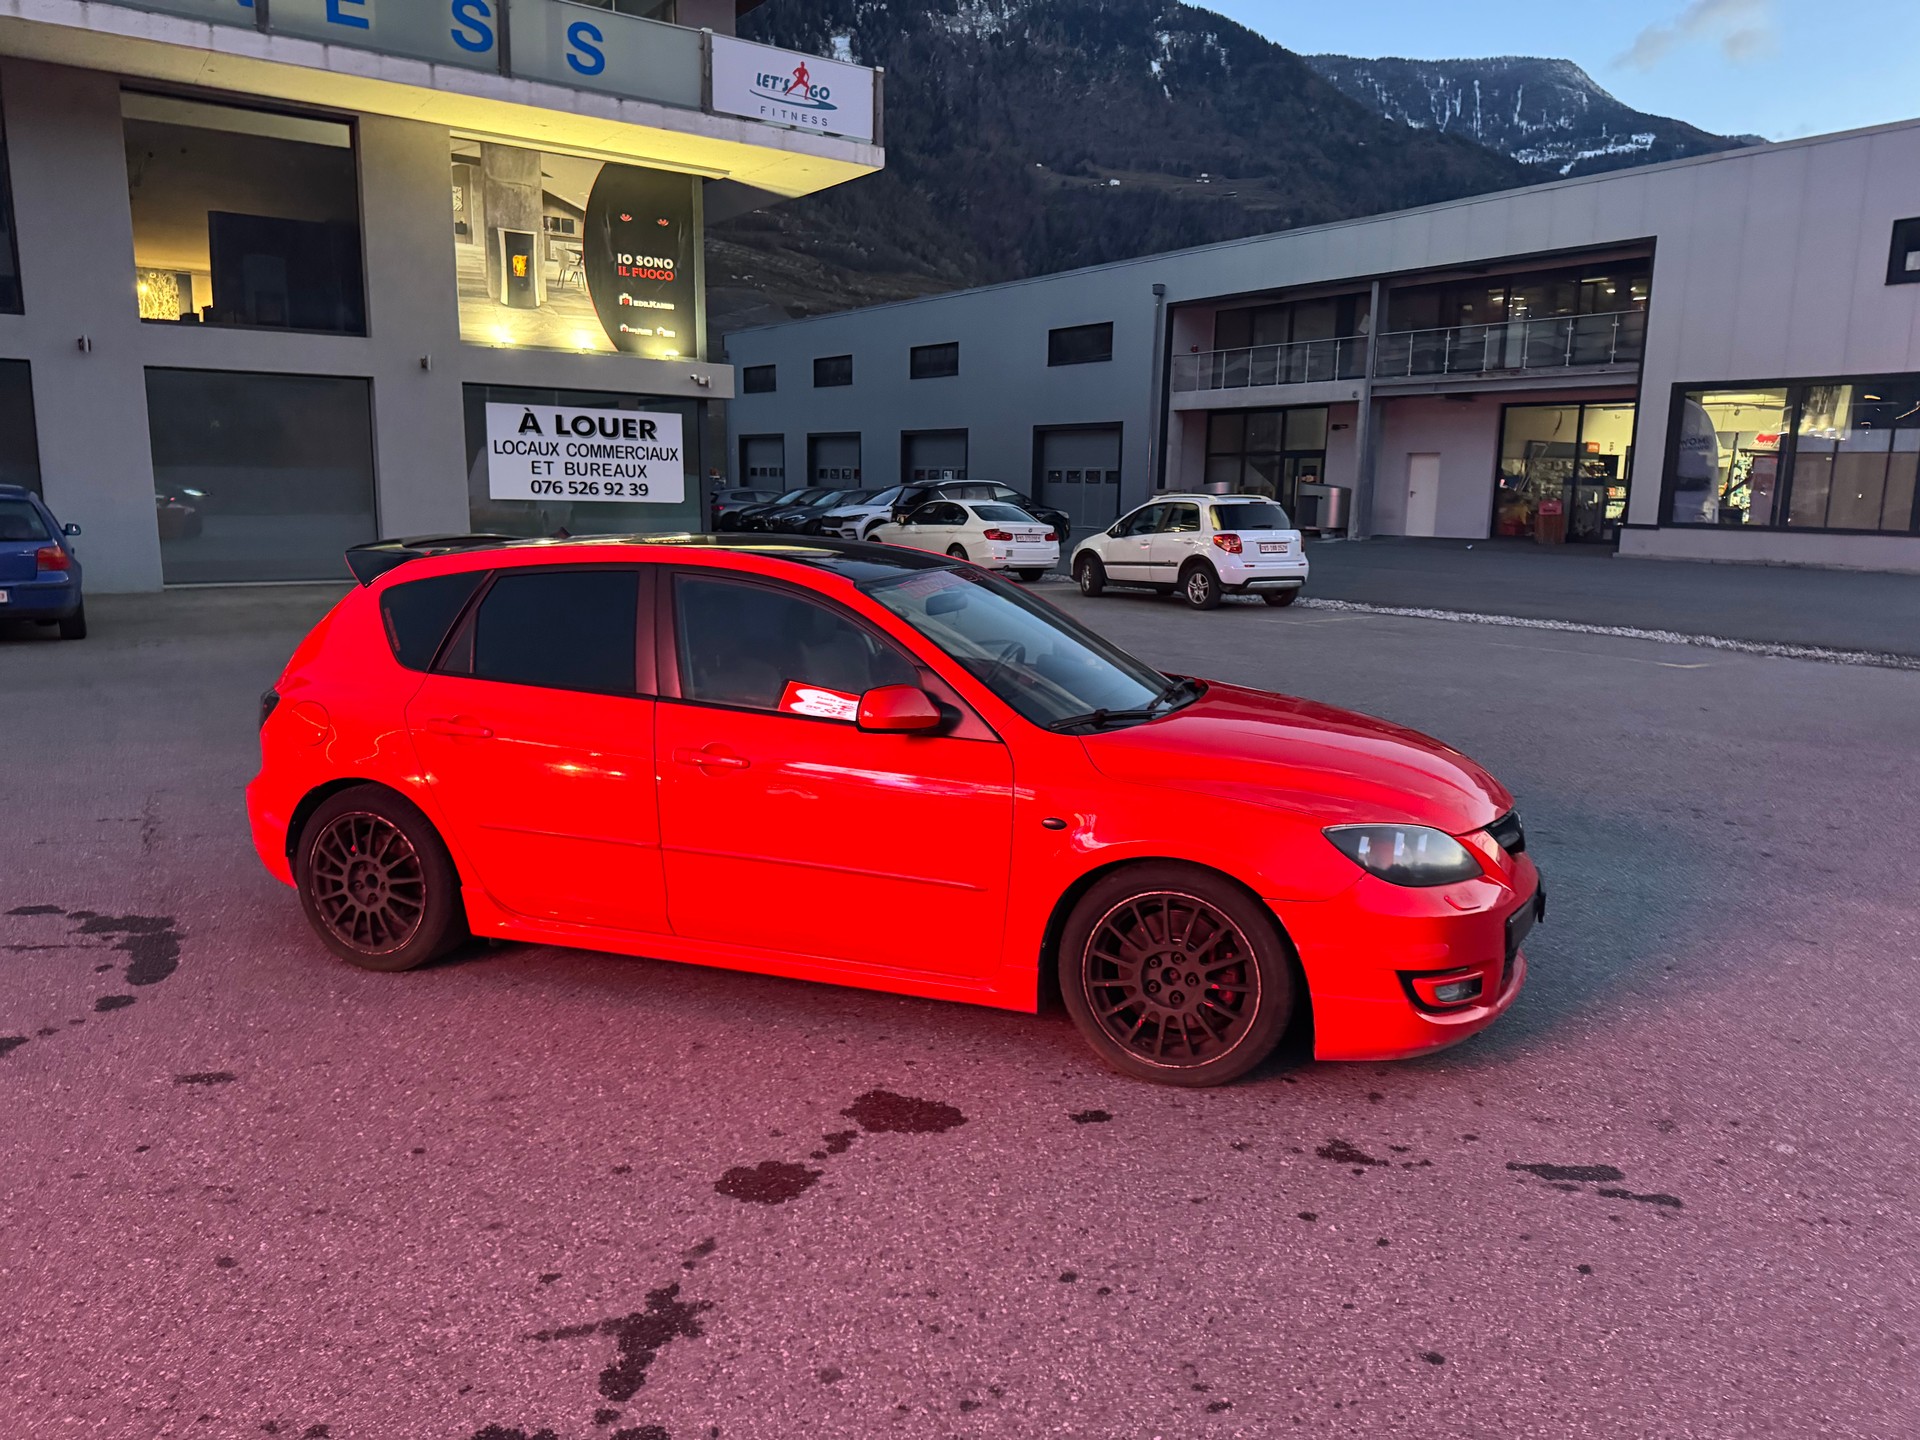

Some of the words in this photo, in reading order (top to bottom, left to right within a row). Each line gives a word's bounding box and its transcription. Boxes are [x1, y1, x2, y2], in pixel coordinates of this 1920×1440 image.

[237, 0, 605, 76] ESS
[756, 73, 790, 92] LET'S
[809, 85, 830, 100] GO
[760, 106, 828, 126] FITNESS
[617, 253, 633, 265] IO
[636, 256, 674, 269] SONO
[617, 266, 630, 277] IL
[632, 268, 674, 281] FUOCO
[518, 407, 544, 436] À
[555, 414, 658, 442] LOUER
[493, 440, 560, 457] LOCAUX
[566, 443, 679, 462] COMMERCIAUX
[531, 460, 554, 475] ET
[564, 462, 648, 479] BUREAUX
[530, 480, 563, 495] 076
[568, 481, 599, 496] 526
[604, 482, 625, 496] 92
[629, 483, 649, 497] 39
